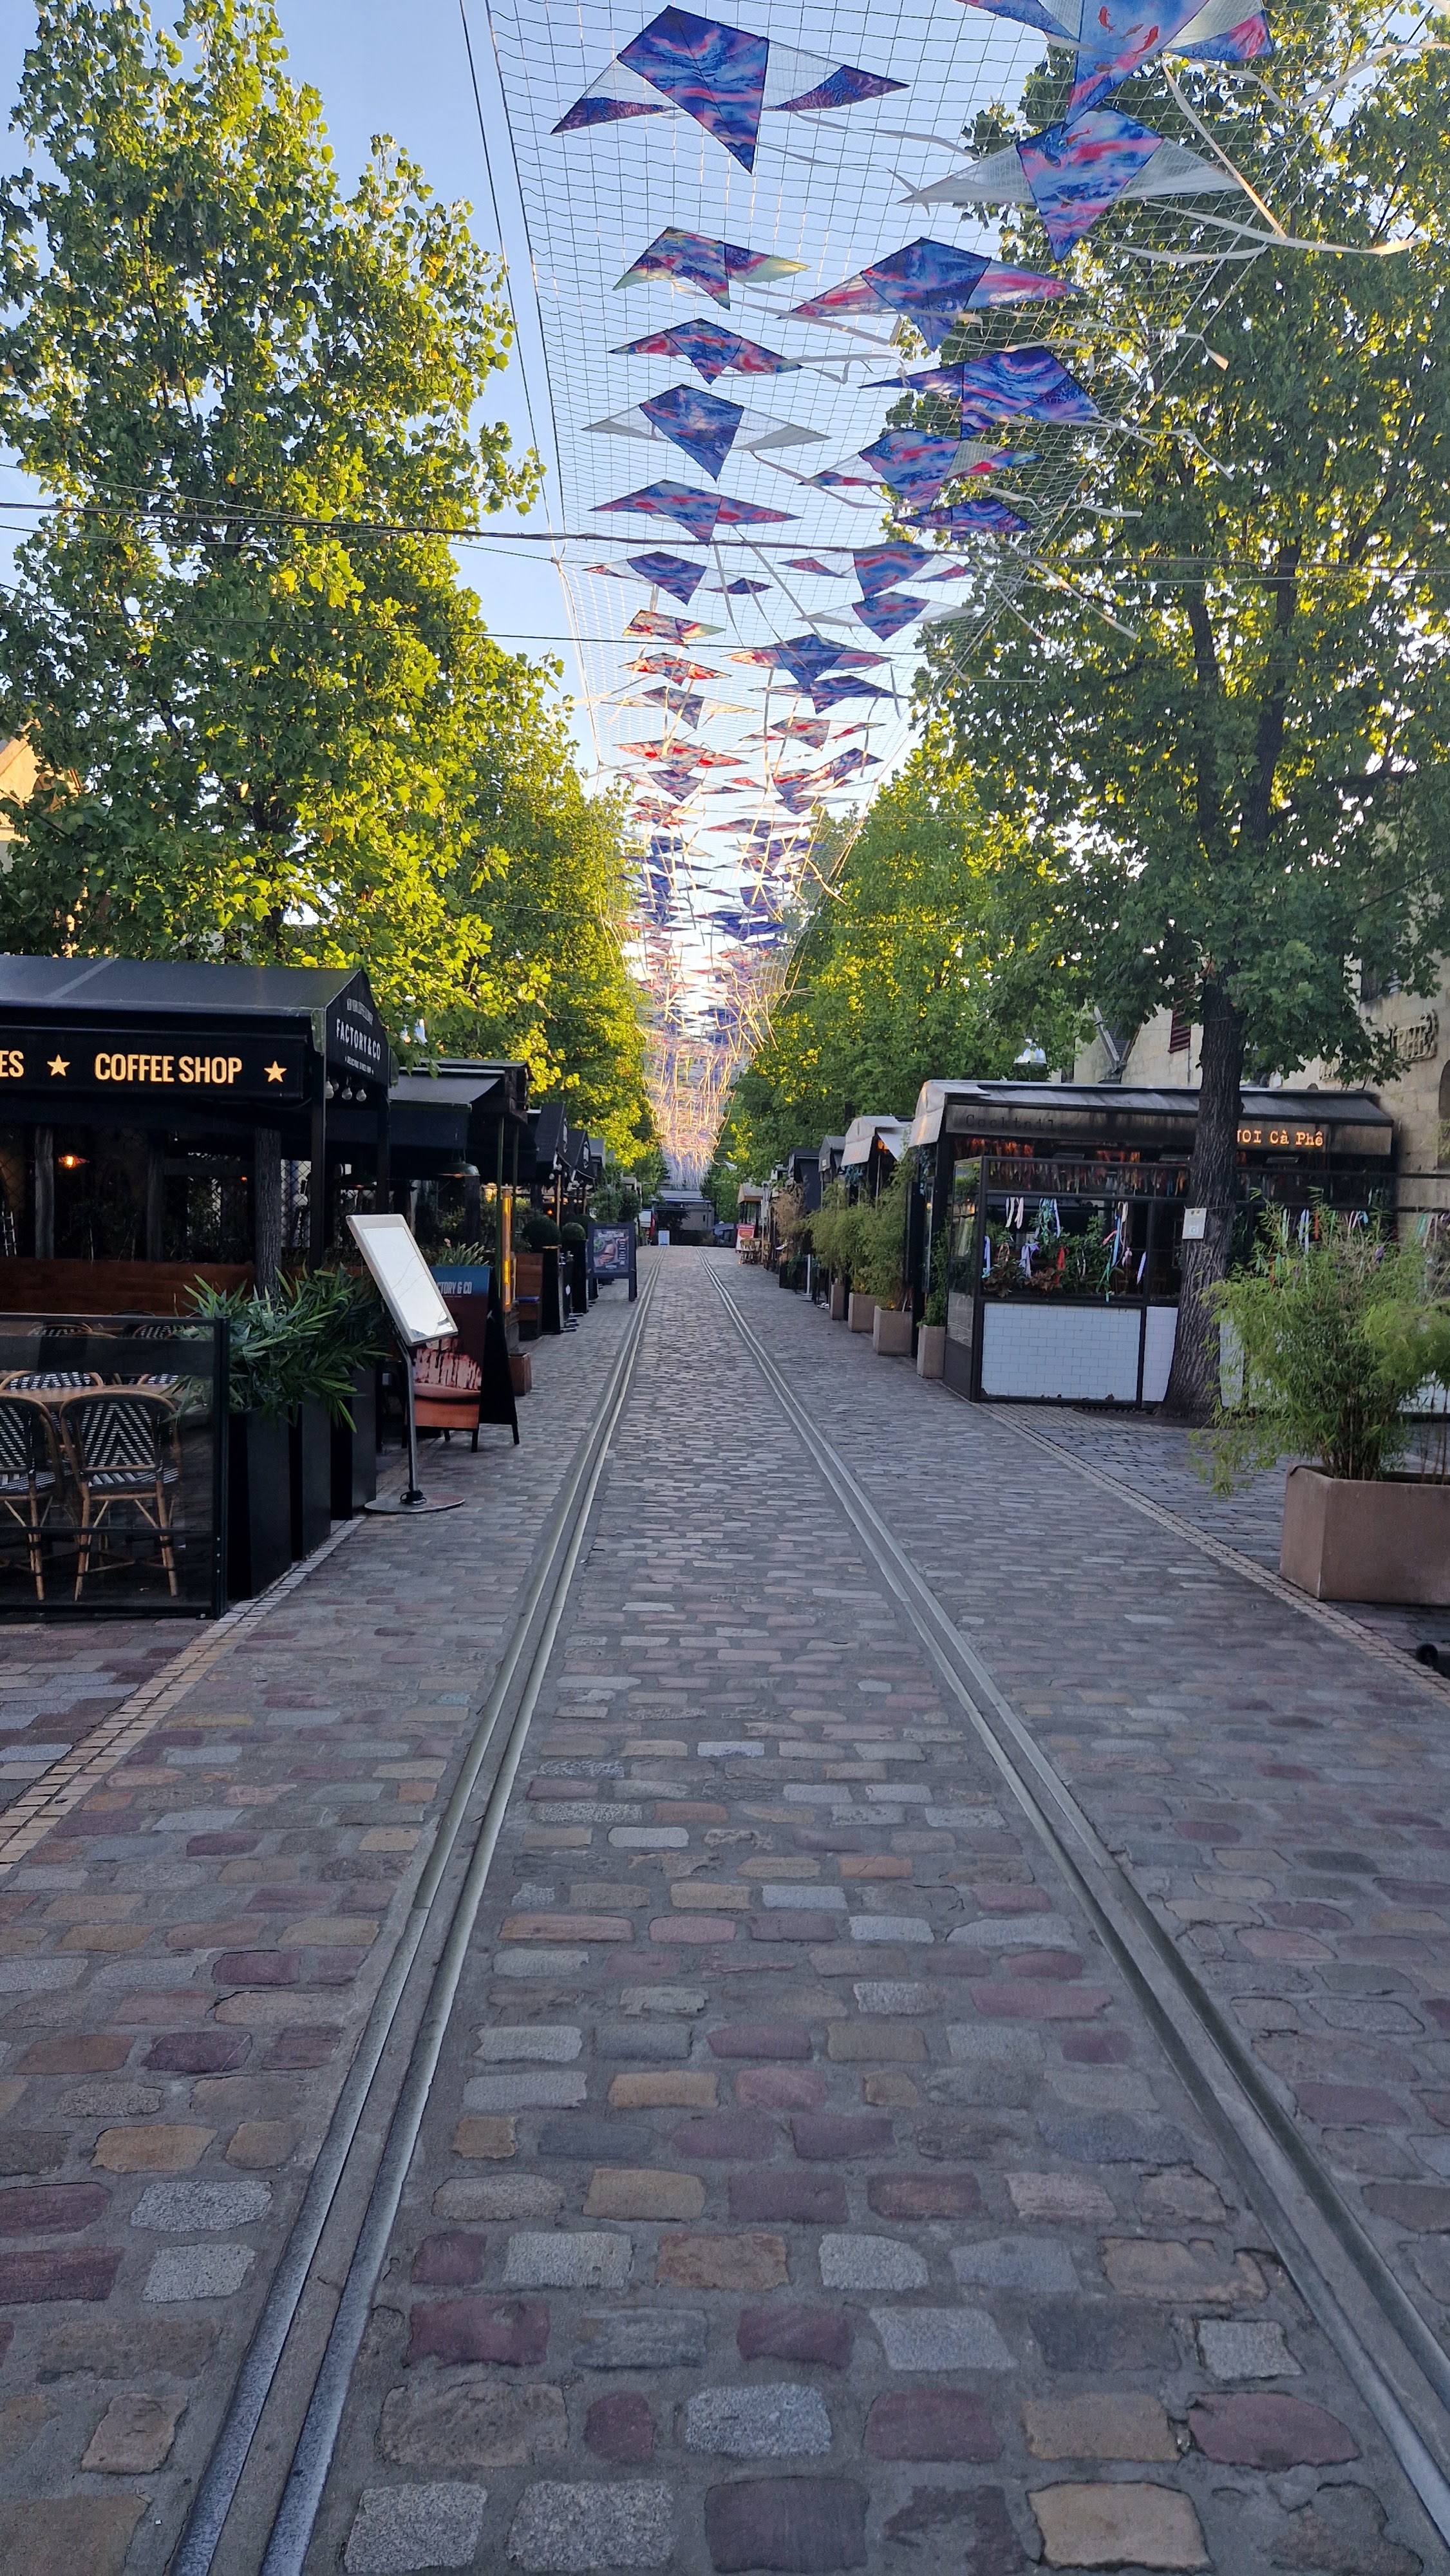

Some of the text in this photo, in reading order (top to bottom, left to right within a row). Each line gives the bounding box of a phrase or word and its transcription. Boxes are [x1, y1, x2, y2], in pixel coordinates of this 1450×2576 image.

[95, 1052, 243, 1084] COFFEE SHOP
[1270, 1130, 1290, 1144] Cà
[1295, 1131, 1324, 1147] Phê
[463, 1282, 472, 1294] CO
